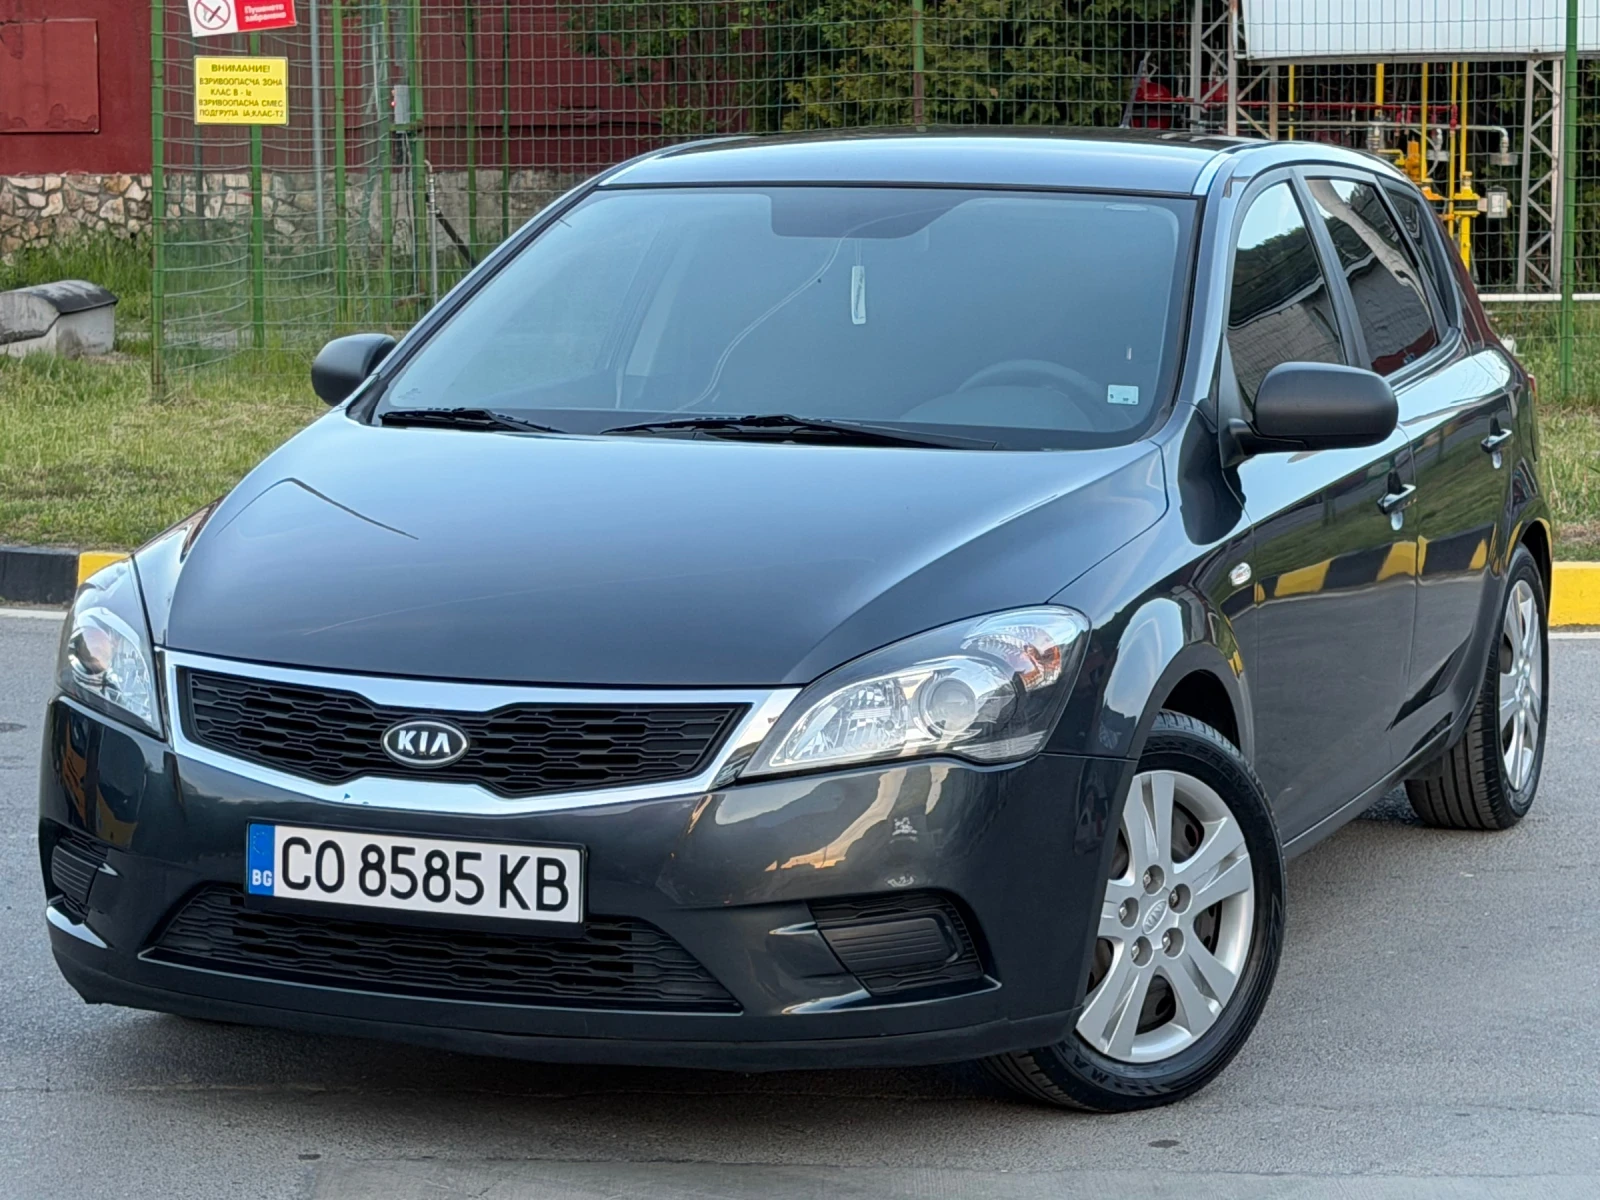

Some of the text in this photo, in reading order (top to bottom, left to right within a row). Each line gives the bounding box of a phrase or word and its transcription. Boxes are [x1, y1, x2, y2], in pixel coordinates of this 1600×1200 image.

[211, 64, 270, 73] ВНИМАНИЕ!
[262, 78, 283, 87] ЗОНА
[210, 88, 231, 96] КЛАС
[199, 99, 283, 107] ВЗРИВООПАСНА СМЕС
[397, 729, 451, 756] KIA
[252, 869, 273, 887] BG
[358, 843, 485, 906] 8585
[498, 853, 570, 913] KB
